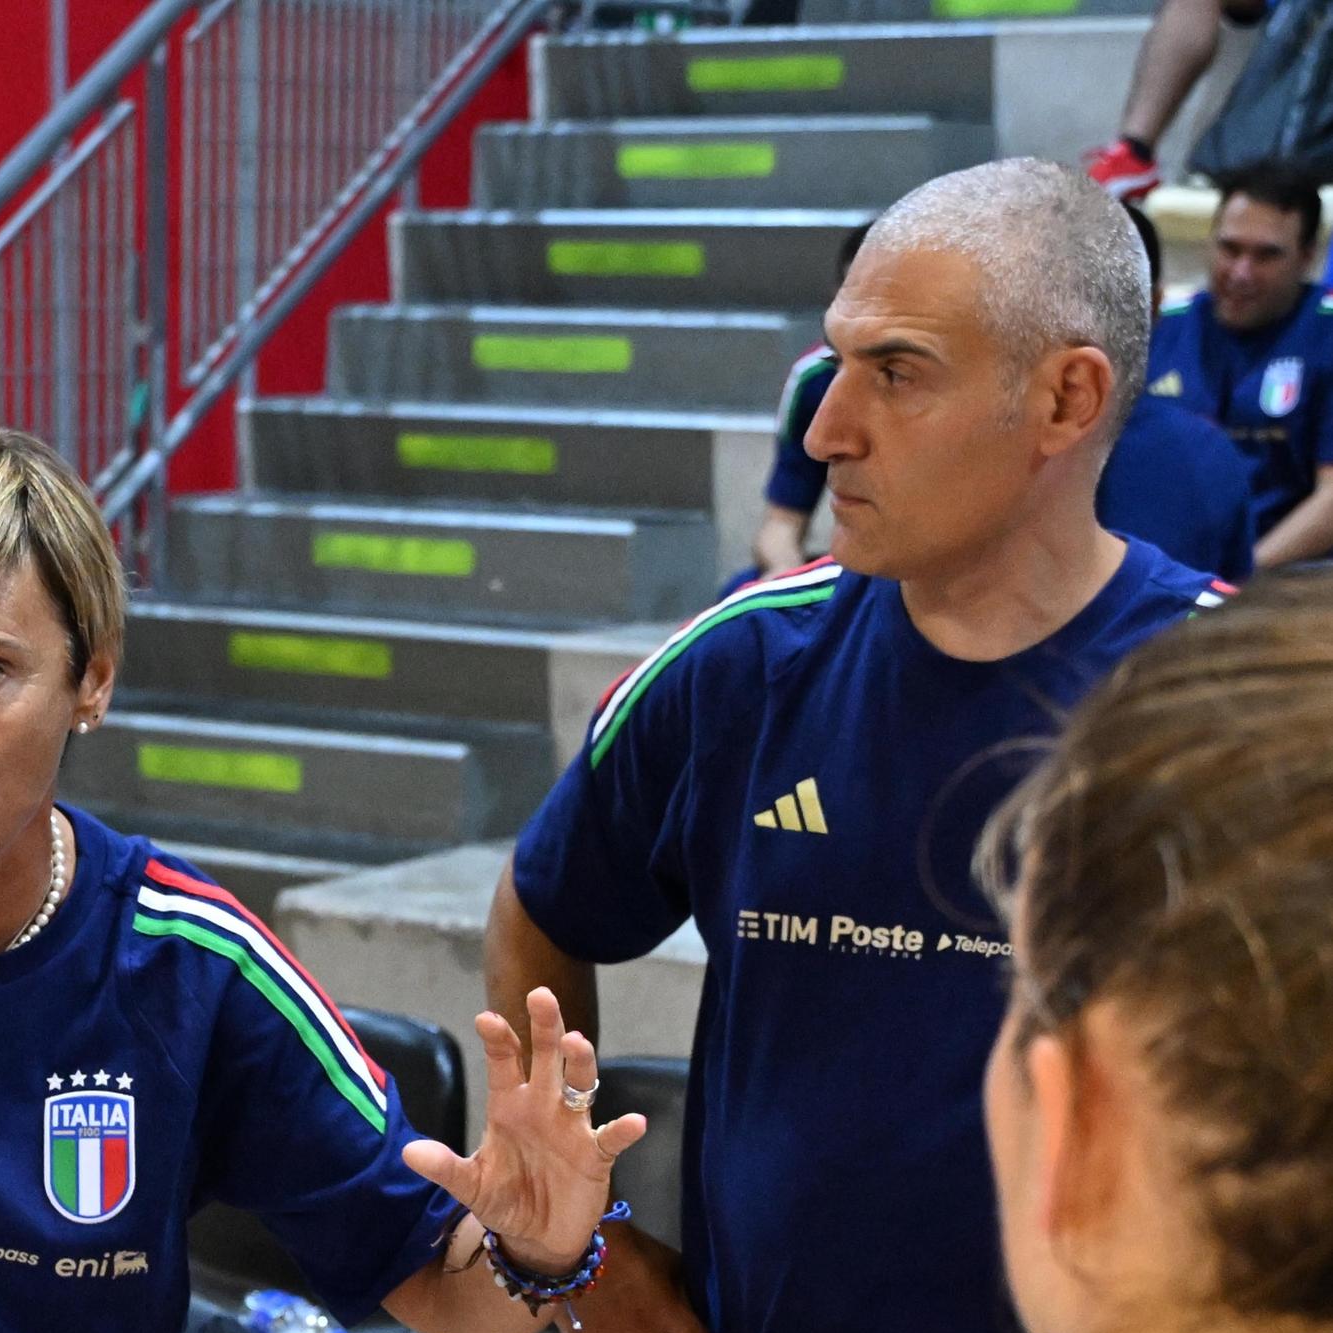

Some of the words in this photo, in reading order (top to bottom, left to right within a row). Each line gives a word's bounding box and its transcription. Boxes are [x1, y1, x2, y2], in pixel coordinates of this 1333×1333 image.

[763, 912, 818, 945] TIM
[830, 915, 924, 952] Poste
[955, 935, 1017, 959] Telepa
[52, 1103, 127, 1128] ITALIA
[54, 1252, 110, 1279] eni
